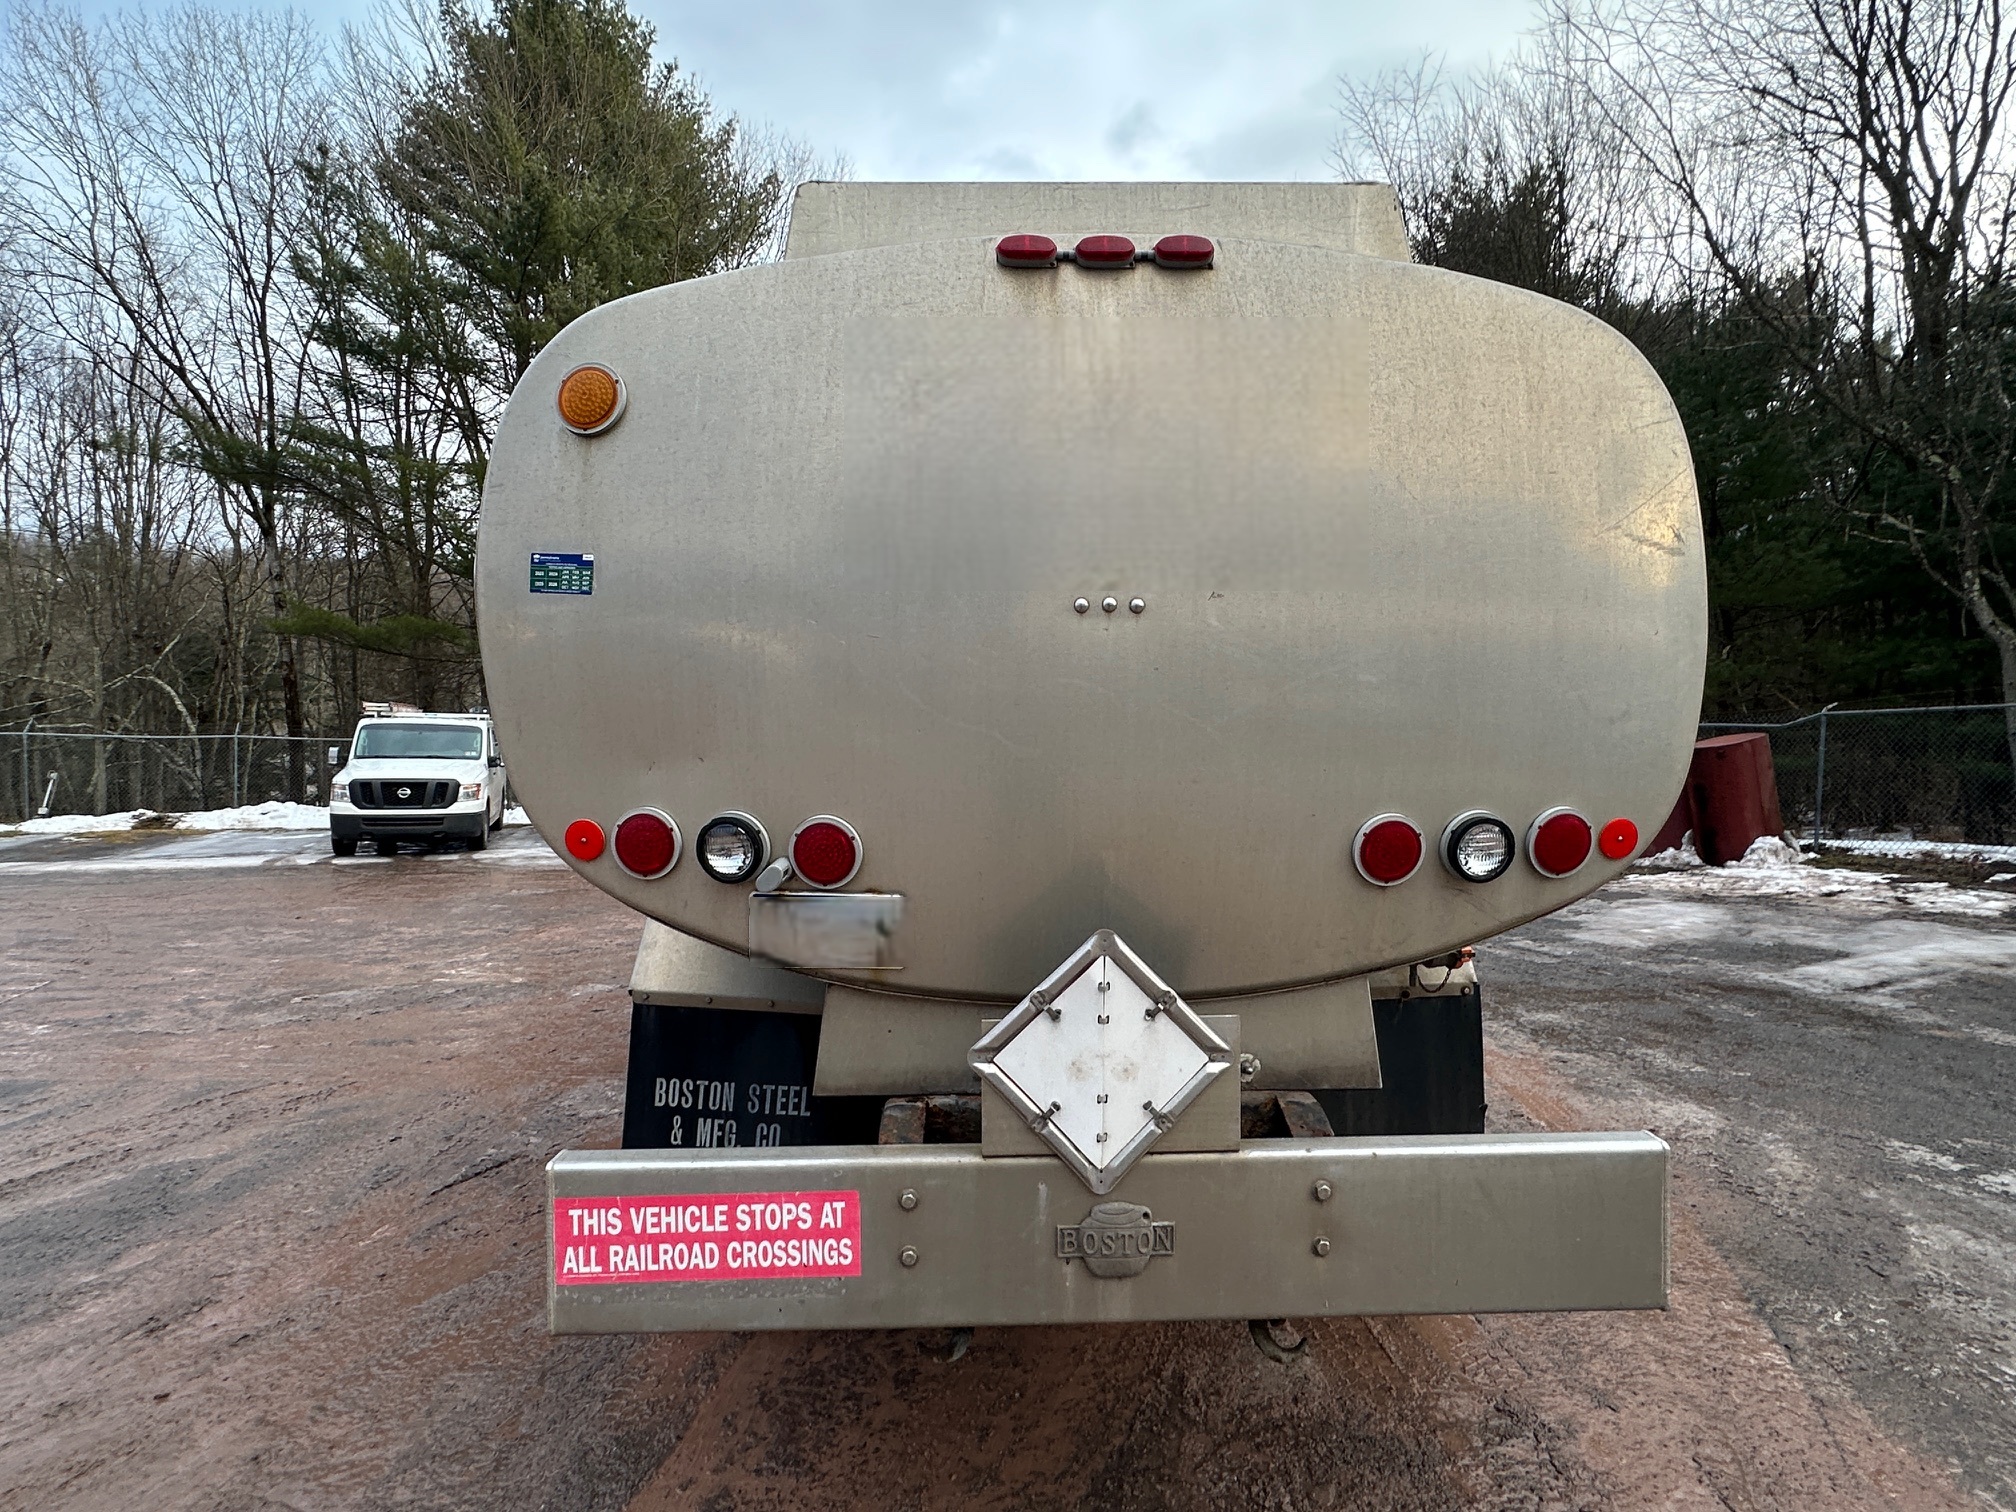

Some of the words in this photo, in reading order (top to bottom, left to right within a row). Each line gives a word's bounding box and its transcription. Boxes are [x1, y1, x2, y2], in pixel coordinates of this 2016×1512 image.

[654, 1077, 736, 1112] BOSTON
[747, 1083, 811, 1117] STEEL
[670, 1115, 683, 1146] &
[568, 1207, 622, 1236] THIS
[629, 1204, 729, 1235] VEHICLE
[735, 1202, 812, 1232] STOPS
[819, 1201, 846, 1230] AT
[562, 1245, 603, 1274] ALL
[608, 1241, 720, 1273] RAILROAD
[726, 1237, 853, 1269] CROSSINGS
[1062, 1226, 1173, 1256] BOSTON
